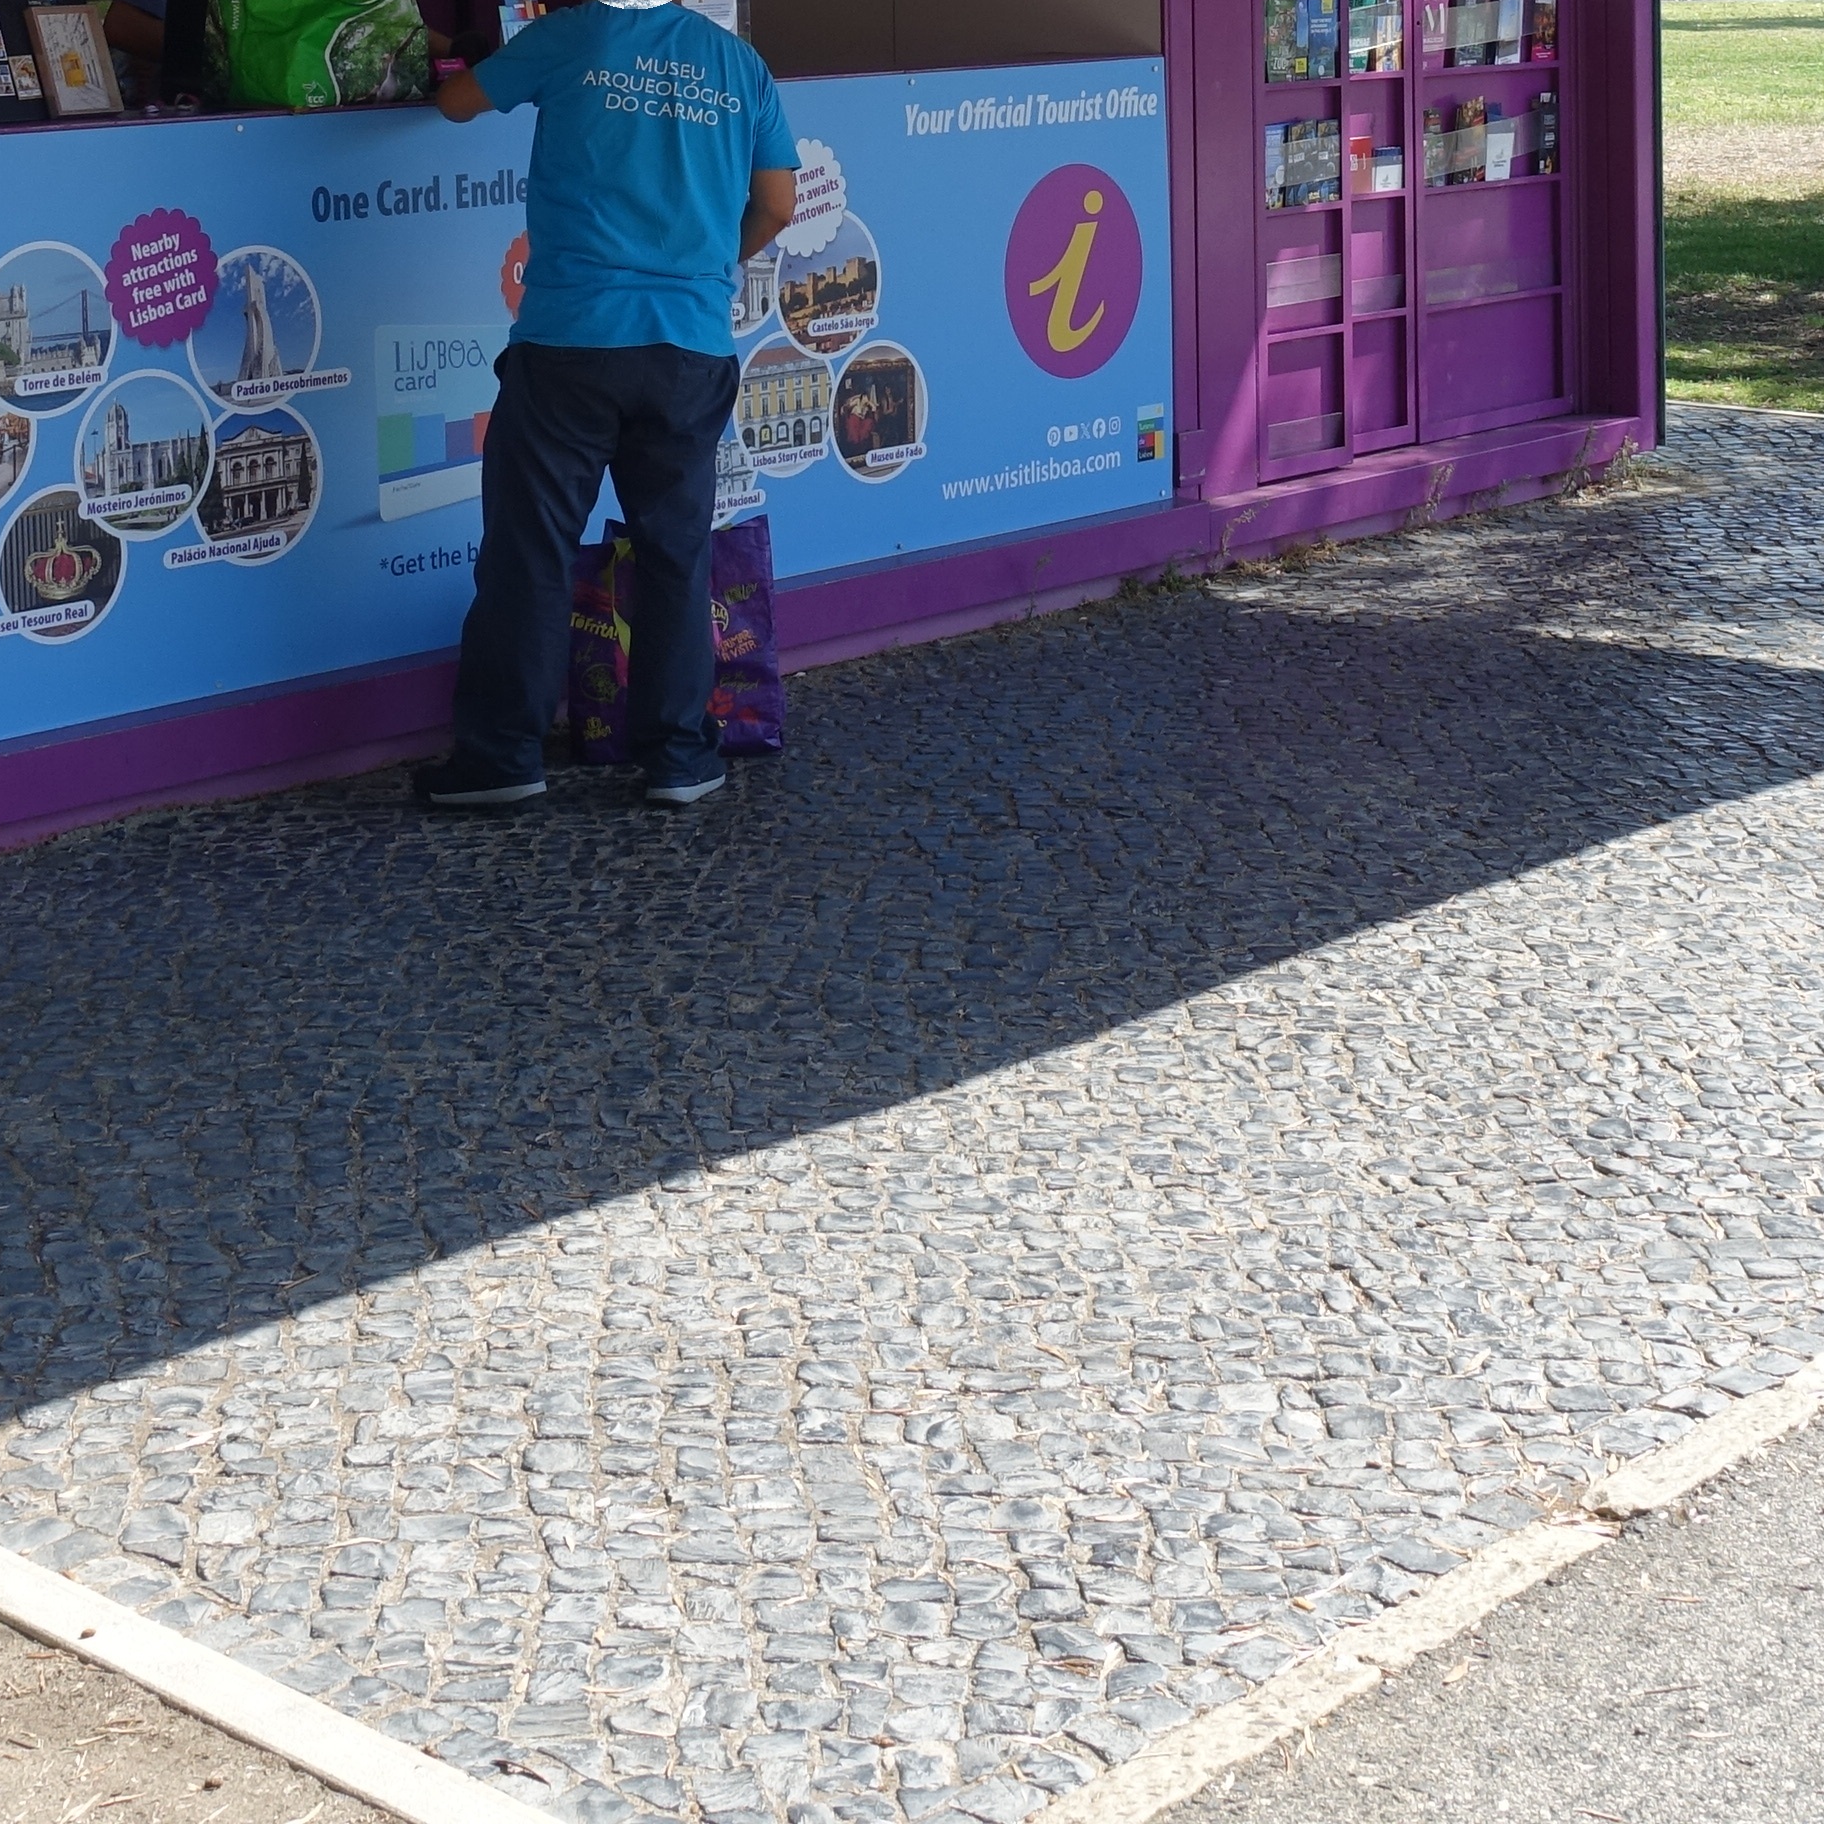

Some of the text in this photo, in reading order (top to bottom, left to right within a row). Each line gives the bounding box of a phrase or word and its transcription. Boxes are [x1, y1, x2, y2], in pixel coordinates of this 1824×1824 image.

[635, 55, 706, 81] MUSEU
[582, 70, 741, 114] ARQUEOLÓGICO
[605, 93, 719, 126] DO CARMO
[904, 86, 1158, 136] Your Official Tourist Office
[799, 165, 826, 184] more
[311, 185, 369, 223] One
[376, 179, 448, 217] Card.
[807, 178, 840, 201] awaits
[130, 233, 181, 262] Nearby
[121, 248, 198, 287] attractions
[131, 268, 196, 305] free with
[129, 285, 207, 328] Lisboa Card
[811, 313, 876, 334] Castelo São Jorge
[22, 370, 102, 392] Torre de Belém
[237, 372, 349, 397] Padrão Descobrimentos
[394, 369, 438, 392] card
[752, 446, 824, 468] Lisboa Story Centre
[870, 444, 923, 463] Museu do Fado
[941, 449, 1121, 501] www.visitlisboa.com
[87, 489, 187, 516] Mosteiro Jerónimos
[727, 490, 762, 509] Nacional
[171, 533, 281, 565] Palácio Nacional Ajuda
[430, 546, 463, 567] the
[20, 611, 63, 629] Tesouro
[64, 603, 88, 621] Real
